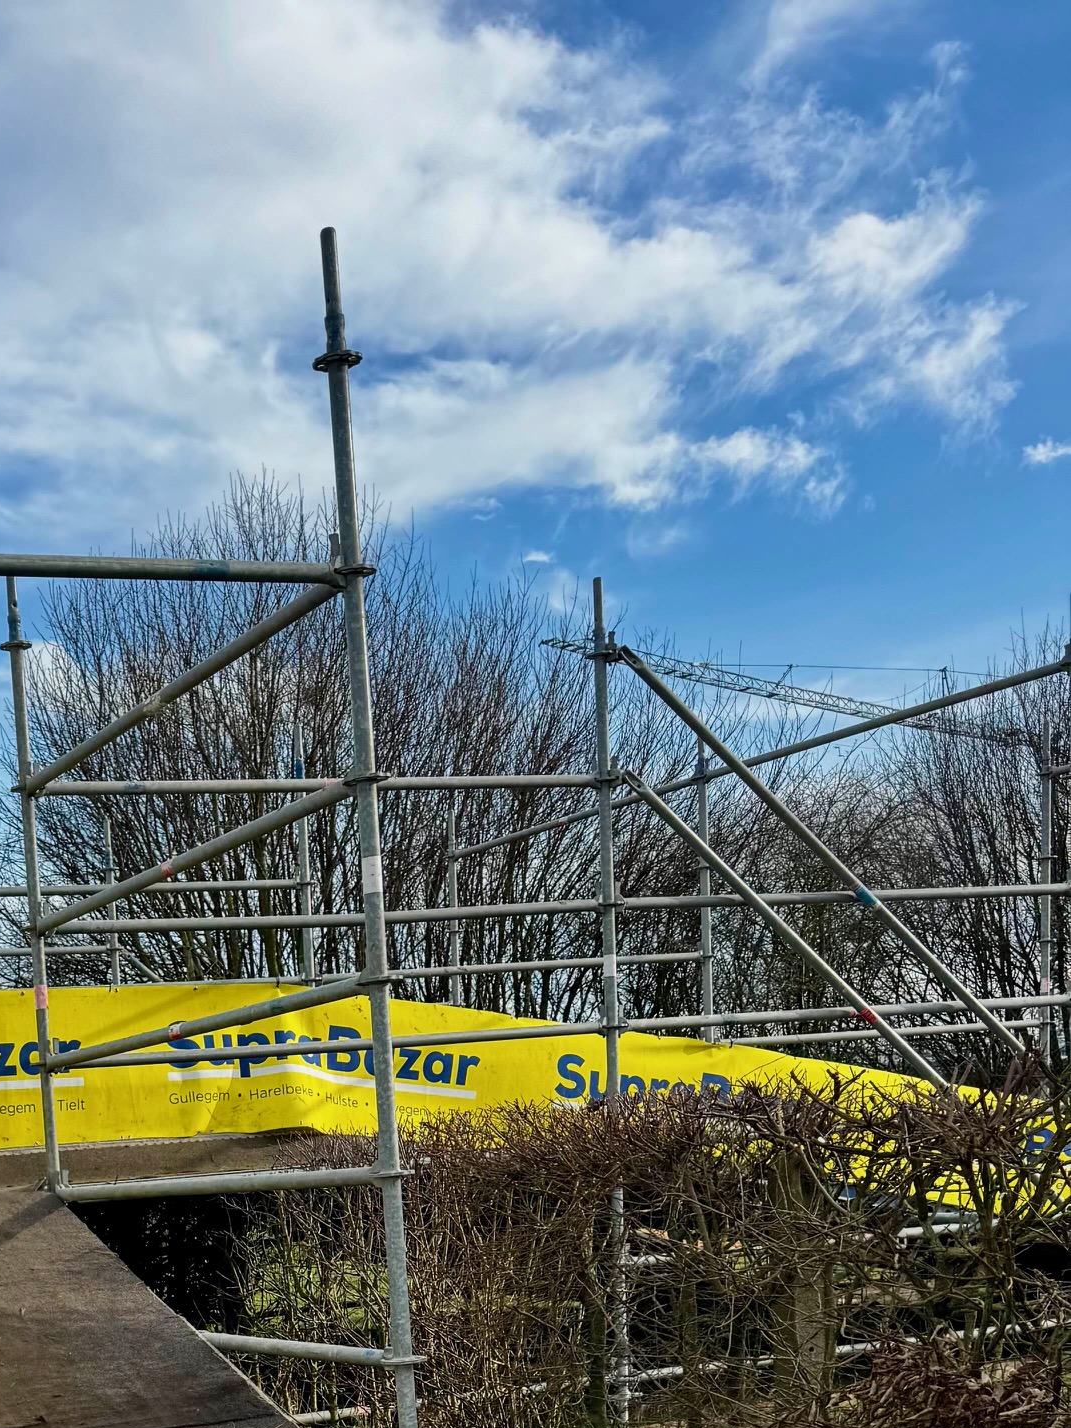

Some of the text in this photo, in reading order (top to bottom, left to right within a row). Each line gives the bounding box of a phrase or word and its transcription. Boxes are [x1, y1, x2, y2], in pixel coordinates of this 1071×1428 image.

[57, 1099, 85, 1112] Tielt
[169, 1090, 230, 1105] Gullegem
[249, 1083, 314, 1100] Harelbeke
[325, 1092, 359, 1109] Hulste
